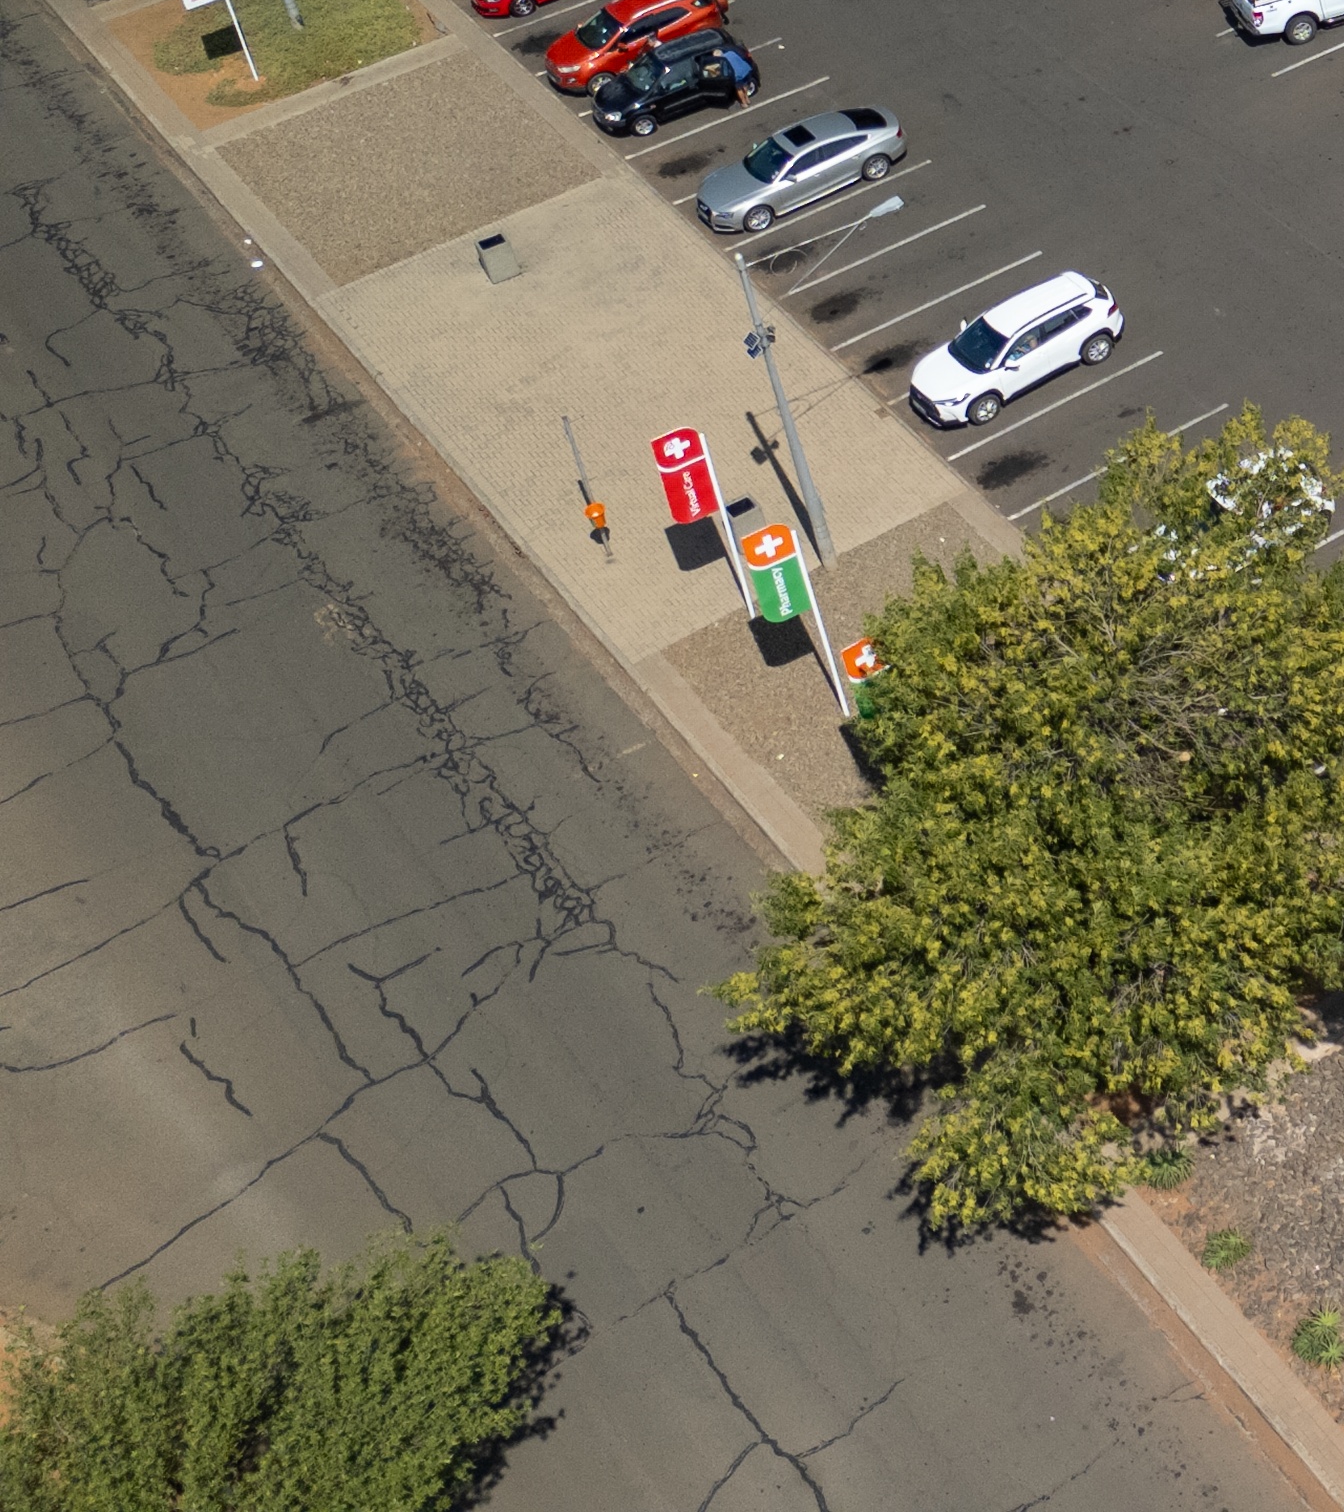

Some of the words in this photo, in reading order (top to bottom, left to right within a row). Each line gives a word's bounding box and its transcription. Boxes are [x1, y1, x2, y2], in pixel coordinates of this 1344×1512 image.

[682, 470, 694, 490] Care
[684, 490, 701, 517] Virtual
[771, 566, 794, 617] Pharmacy
